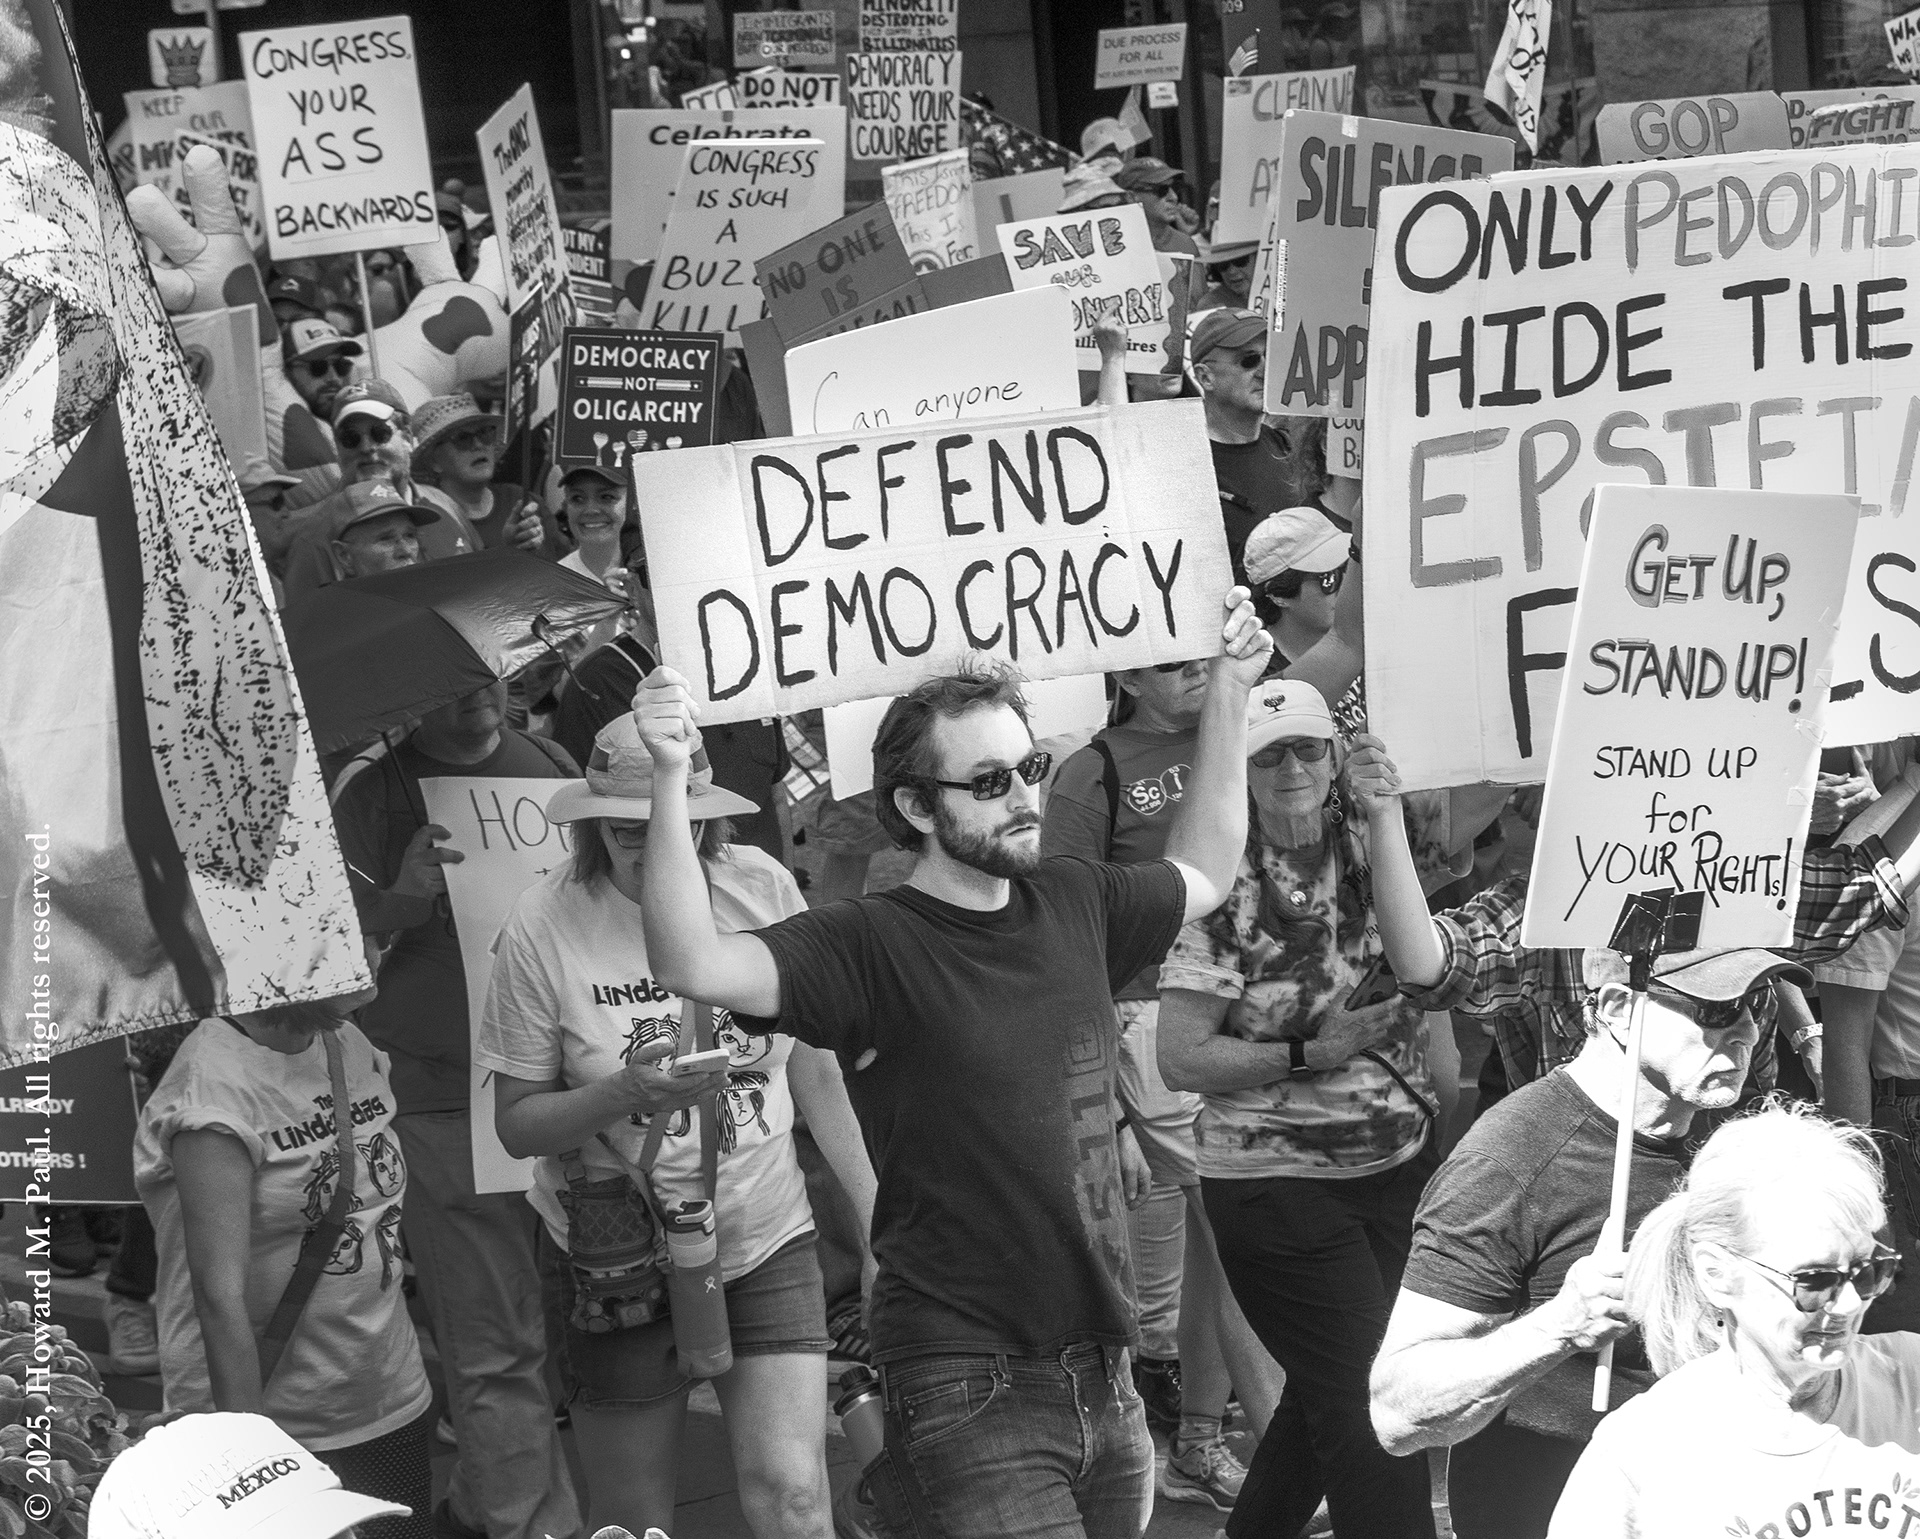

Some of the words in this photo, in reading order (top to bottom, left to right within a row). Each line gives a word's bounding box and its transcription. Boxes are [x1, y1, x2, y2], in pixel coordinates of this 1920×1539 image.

[862, 14, 949, 27] DESTROYING
[1104, 37, 1126, 49] DUE
[1131, 32, 1181, 46] PROCESS
[1118, 51, 1140, 63] FOR
[1144, 50, 1164, 61] ALL
[744, 77, 775, 97] DO
[783, 77, 839, 102] NOT
[847, 54, 955, 88] DEMOCRACY
[288, 83, 376, 126] YOUR
[851, 90, 902, 123] NEEDS
[910, 90, 956, 122] YOUR
[1810, 99, 1916, 139] FIGHT
[648, 123, 812, 146] Celebrate
[856, 123, 949, 157] COURAGE
[1630, 98, 1739, 156] GOP
[282, 126, 383, 178] ASS
[690, 146, 819, 185] CONGRESS
[274, 190, 434, 238] BACKWARDS
[696, 188, 720, 209] IS
[728, 187, 789, 209] SUCH
[715, 218, 738, 245] A
[1013, 217, 1126, 271] SAVE
[1395, 180, 1614, 294] ONLY
[1625, 162, 1920, 276] PEDOPHI
[768, 260, 807, 299] NO
[817, 218, 886, 274] ONE
[1050, 263, 1102, 288] OUR
[819, 274, 859, 317] IS
[573, 344, 711, 371] DEMOCRACY
[1415, 292, 1673, 418] HIDE
[1722, 277, 1914, 372] THE
[624, 376, 657, 391] NOT
[813, 370, 890, 434] Can
[915, 381, 1023, 419] anyone
[573, 398, 704, 424] OLIGARCHY
[698, 538, 1183, 702] DEMOCRACY
[1583, 638, 1727, 700] STAND
[1734, 637, 1808, 714] UP!
[1593, 745, 1691, 779] STAND
[1707, 747, 1757, 779] UP
[1131, 786, 1161, 806] Sc
[1645, 791, 1712, 834] for
[1564, 835, 1684, 922] YOUR
[216, 1458, 301, 1510] MÉXICO
